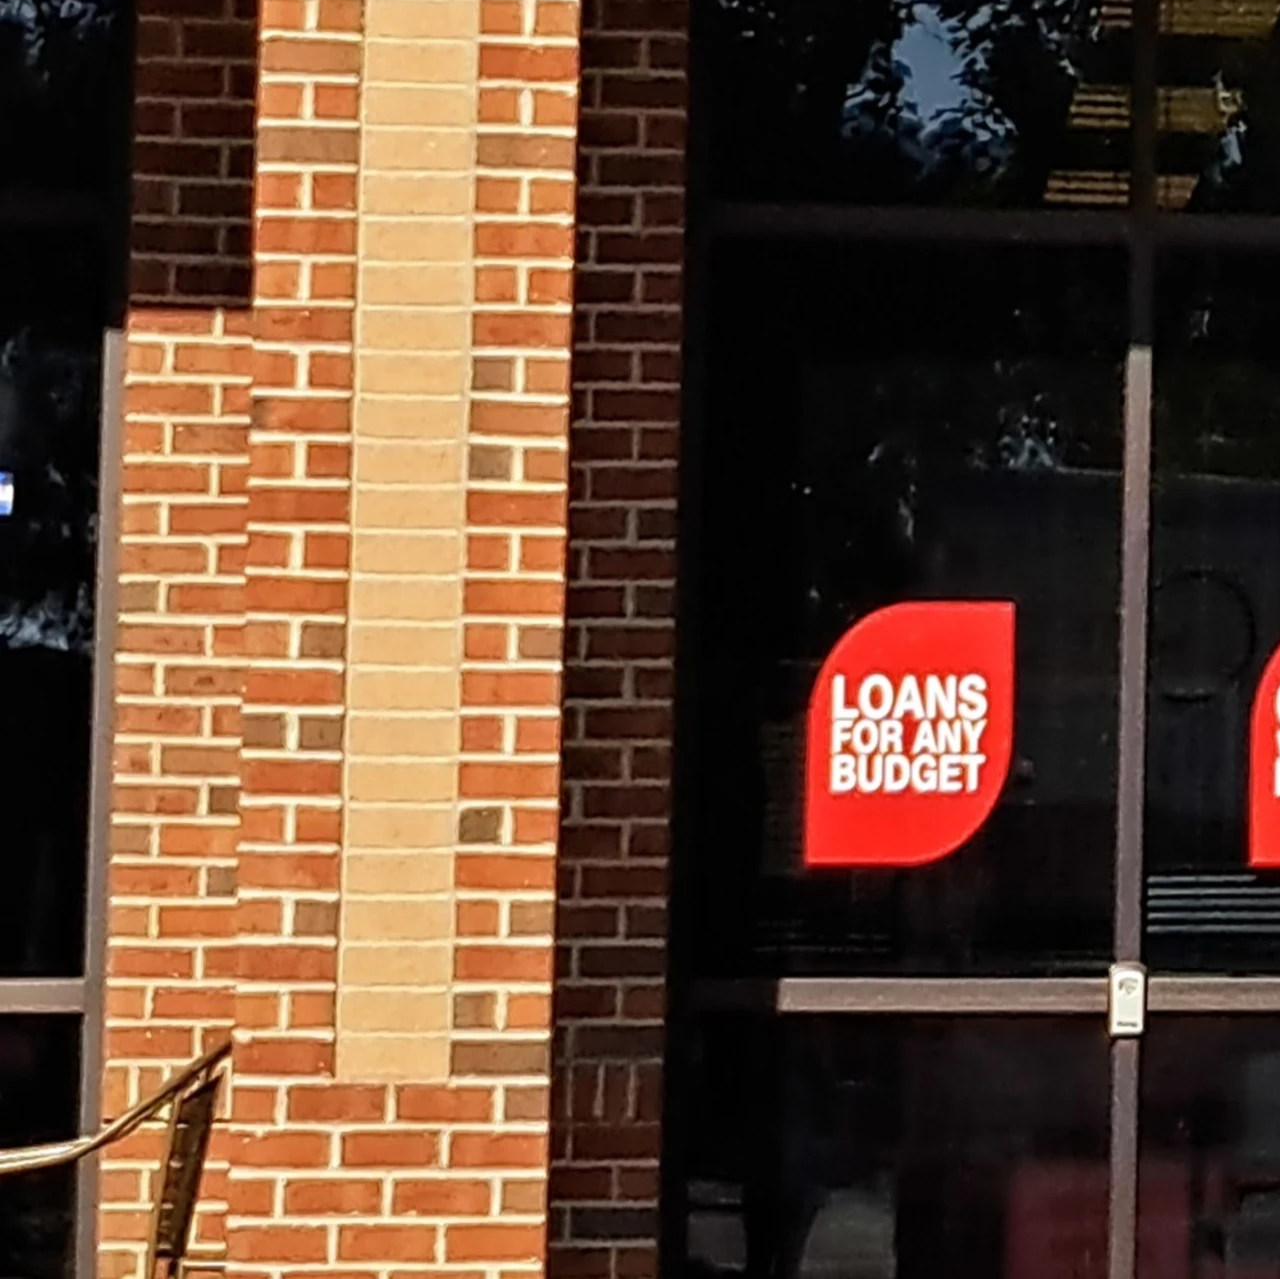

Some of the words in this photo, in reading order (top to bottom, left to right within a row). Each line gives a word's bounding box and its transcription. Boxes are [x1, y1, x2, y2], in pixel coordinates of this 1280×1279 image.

[831, 673, 989, 720] LOANS
[832, 719, 904, 754] FOR
[911, 719, 987, 754] ANY
[829, 754, 987, 794] BUDGET
